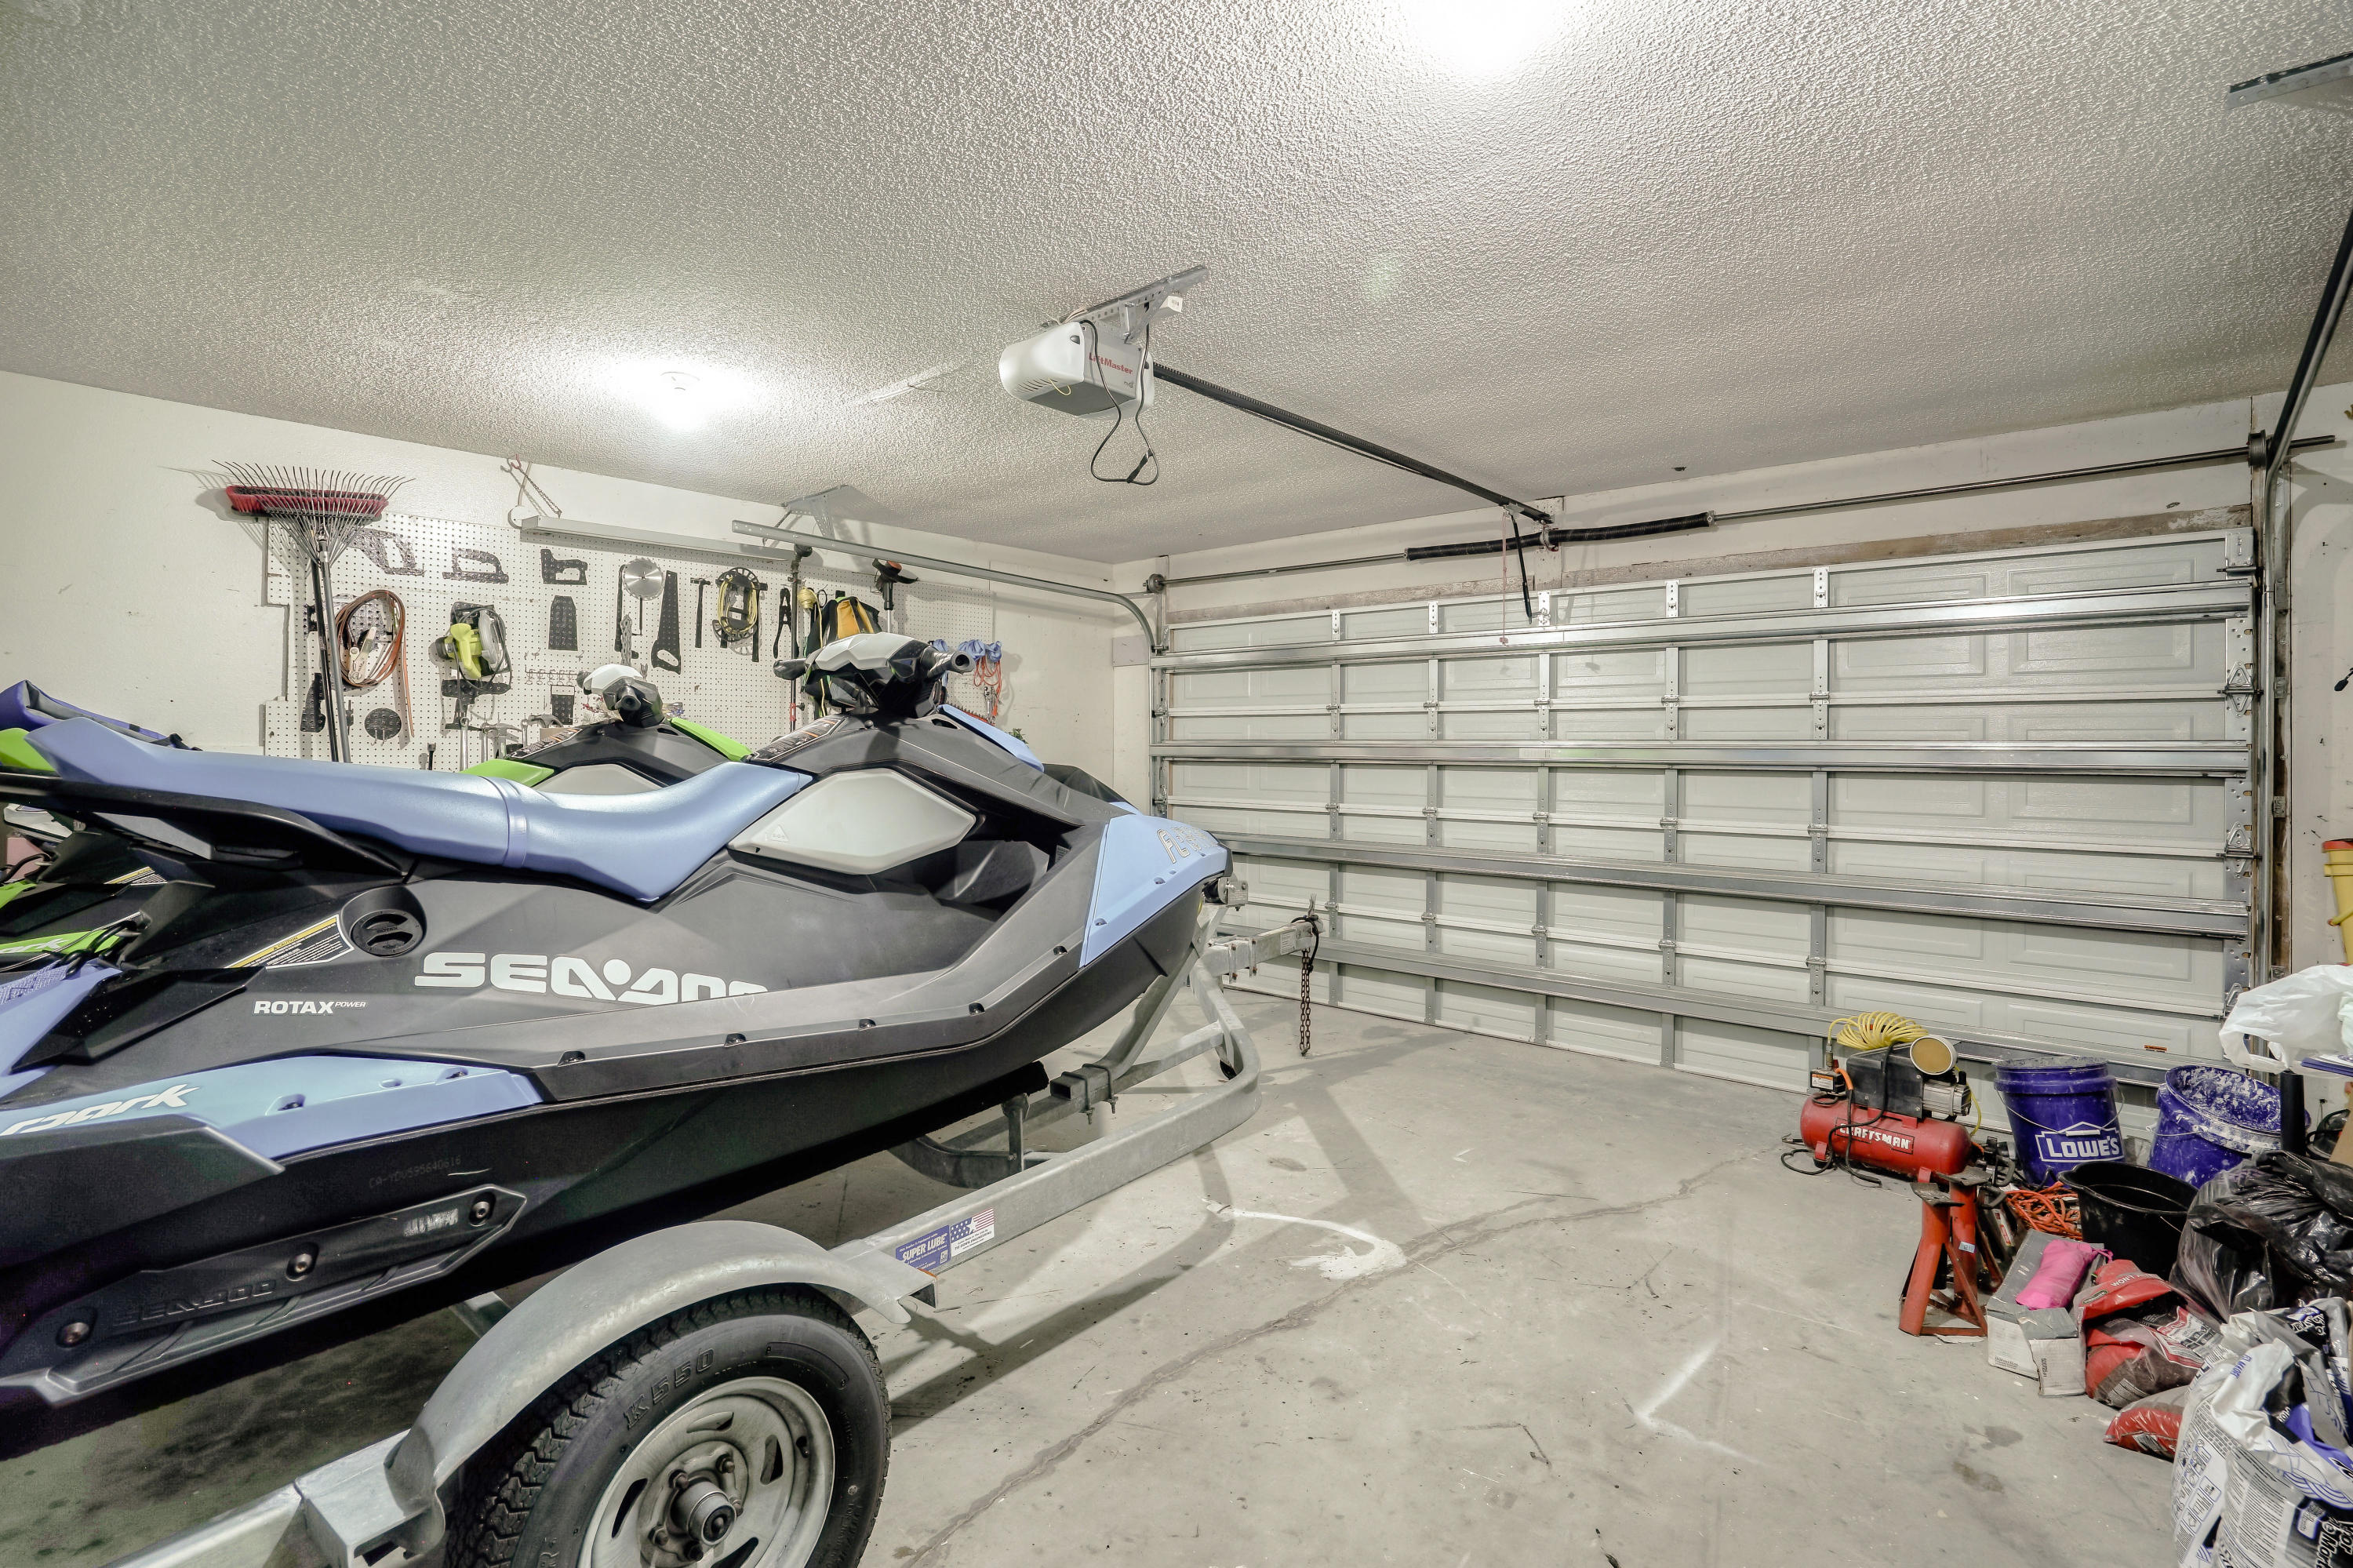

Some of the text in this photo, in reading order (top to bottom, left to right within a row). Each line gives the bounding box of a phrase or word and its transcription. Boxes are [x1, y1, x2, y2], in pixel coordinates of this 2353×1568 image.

[1089, 352, 1133, 376] LiftMaster
[1157, 829, 1191, 864] FL
[253, 1000, 334, 1014] ROTAX
[1839, 1123, 1910, 1150] CRAFTSMAN
[2046, 1135, 2120, 1158] LOWE'S
[902, 1242, 926, 1262] SUPER
[926, 1235, 946, 1252] LUBE
[2111, 1274, 2136, 1287] WON'T
